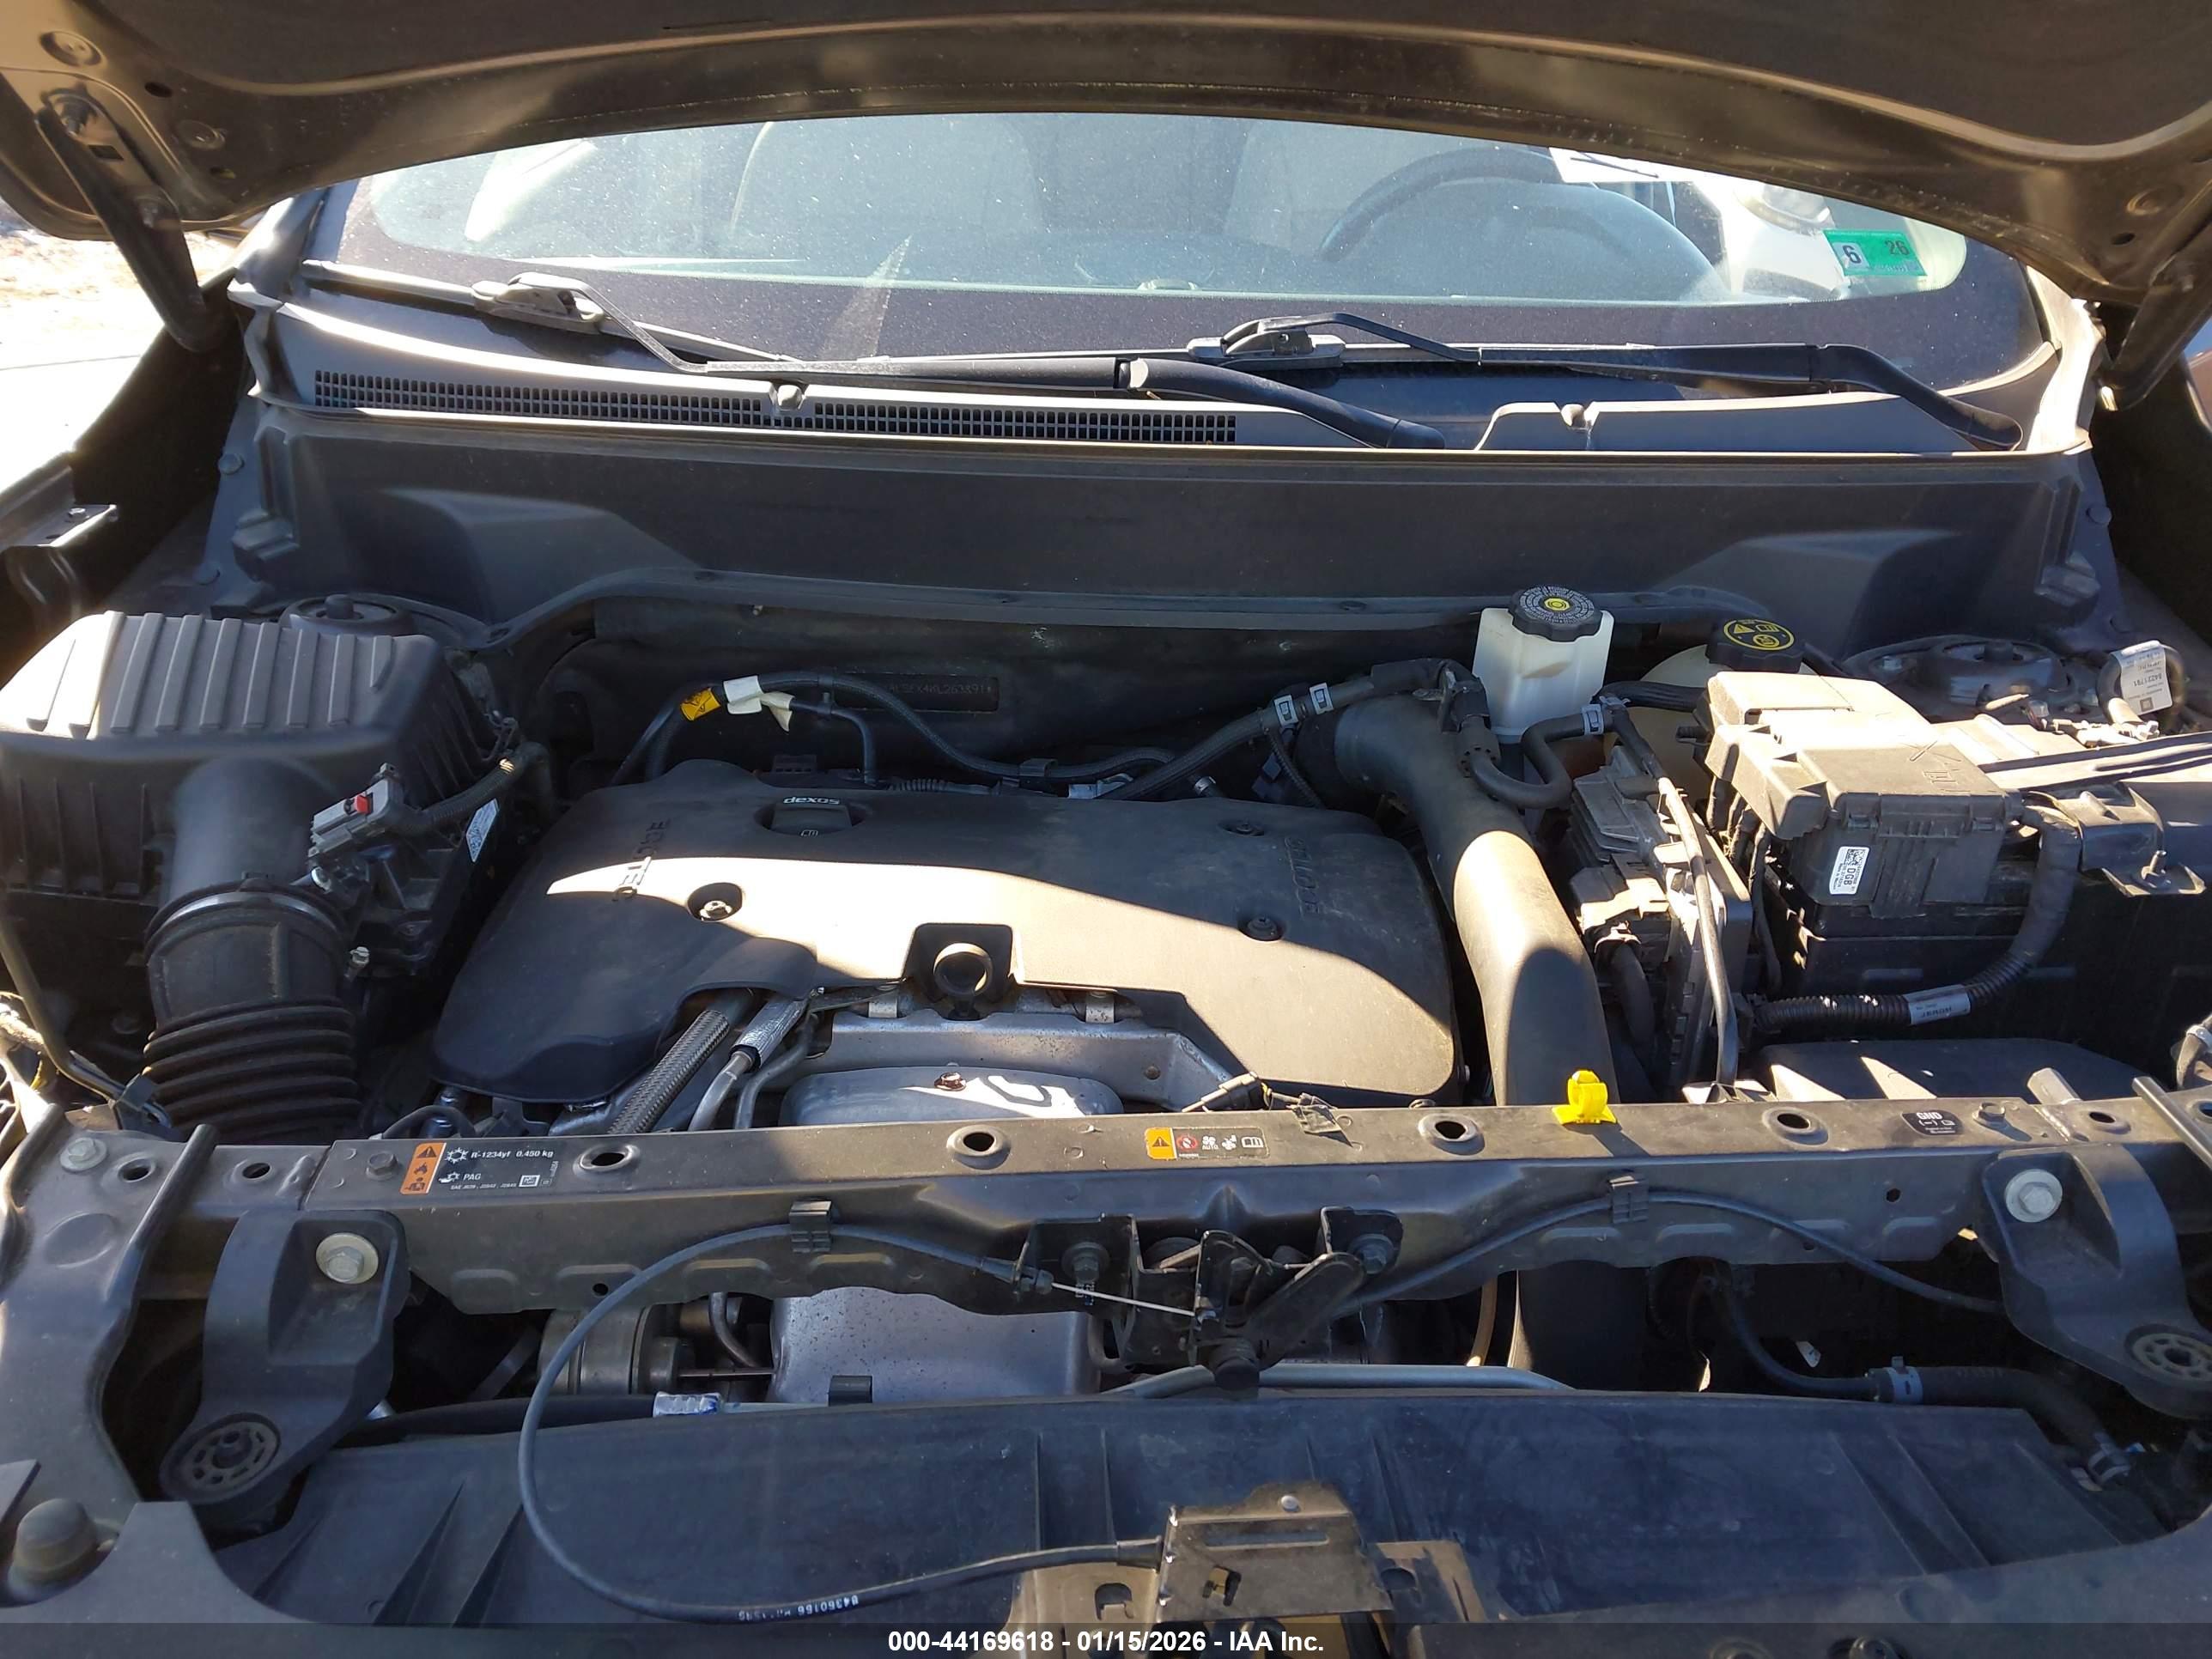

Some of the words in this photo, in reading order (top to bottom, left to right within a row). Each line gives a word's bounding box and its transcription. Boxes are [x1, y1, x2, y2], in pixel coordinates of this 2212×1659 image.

[1841, 245, 1862, 264] 6
[1884, 239, 1910, 256] 26
[782, 795, 841, 805] dexos
[1844, 867, 1856, 885] DGB
[1916, 1111, 1943, 1120] GND
[470, 1149, 512, 1159] R-1234yf
[514, 1150, 541, 1158] 0.450
[541, 1150, 554, 1159] kg
[462, 1172, 482, 1182] PAG
